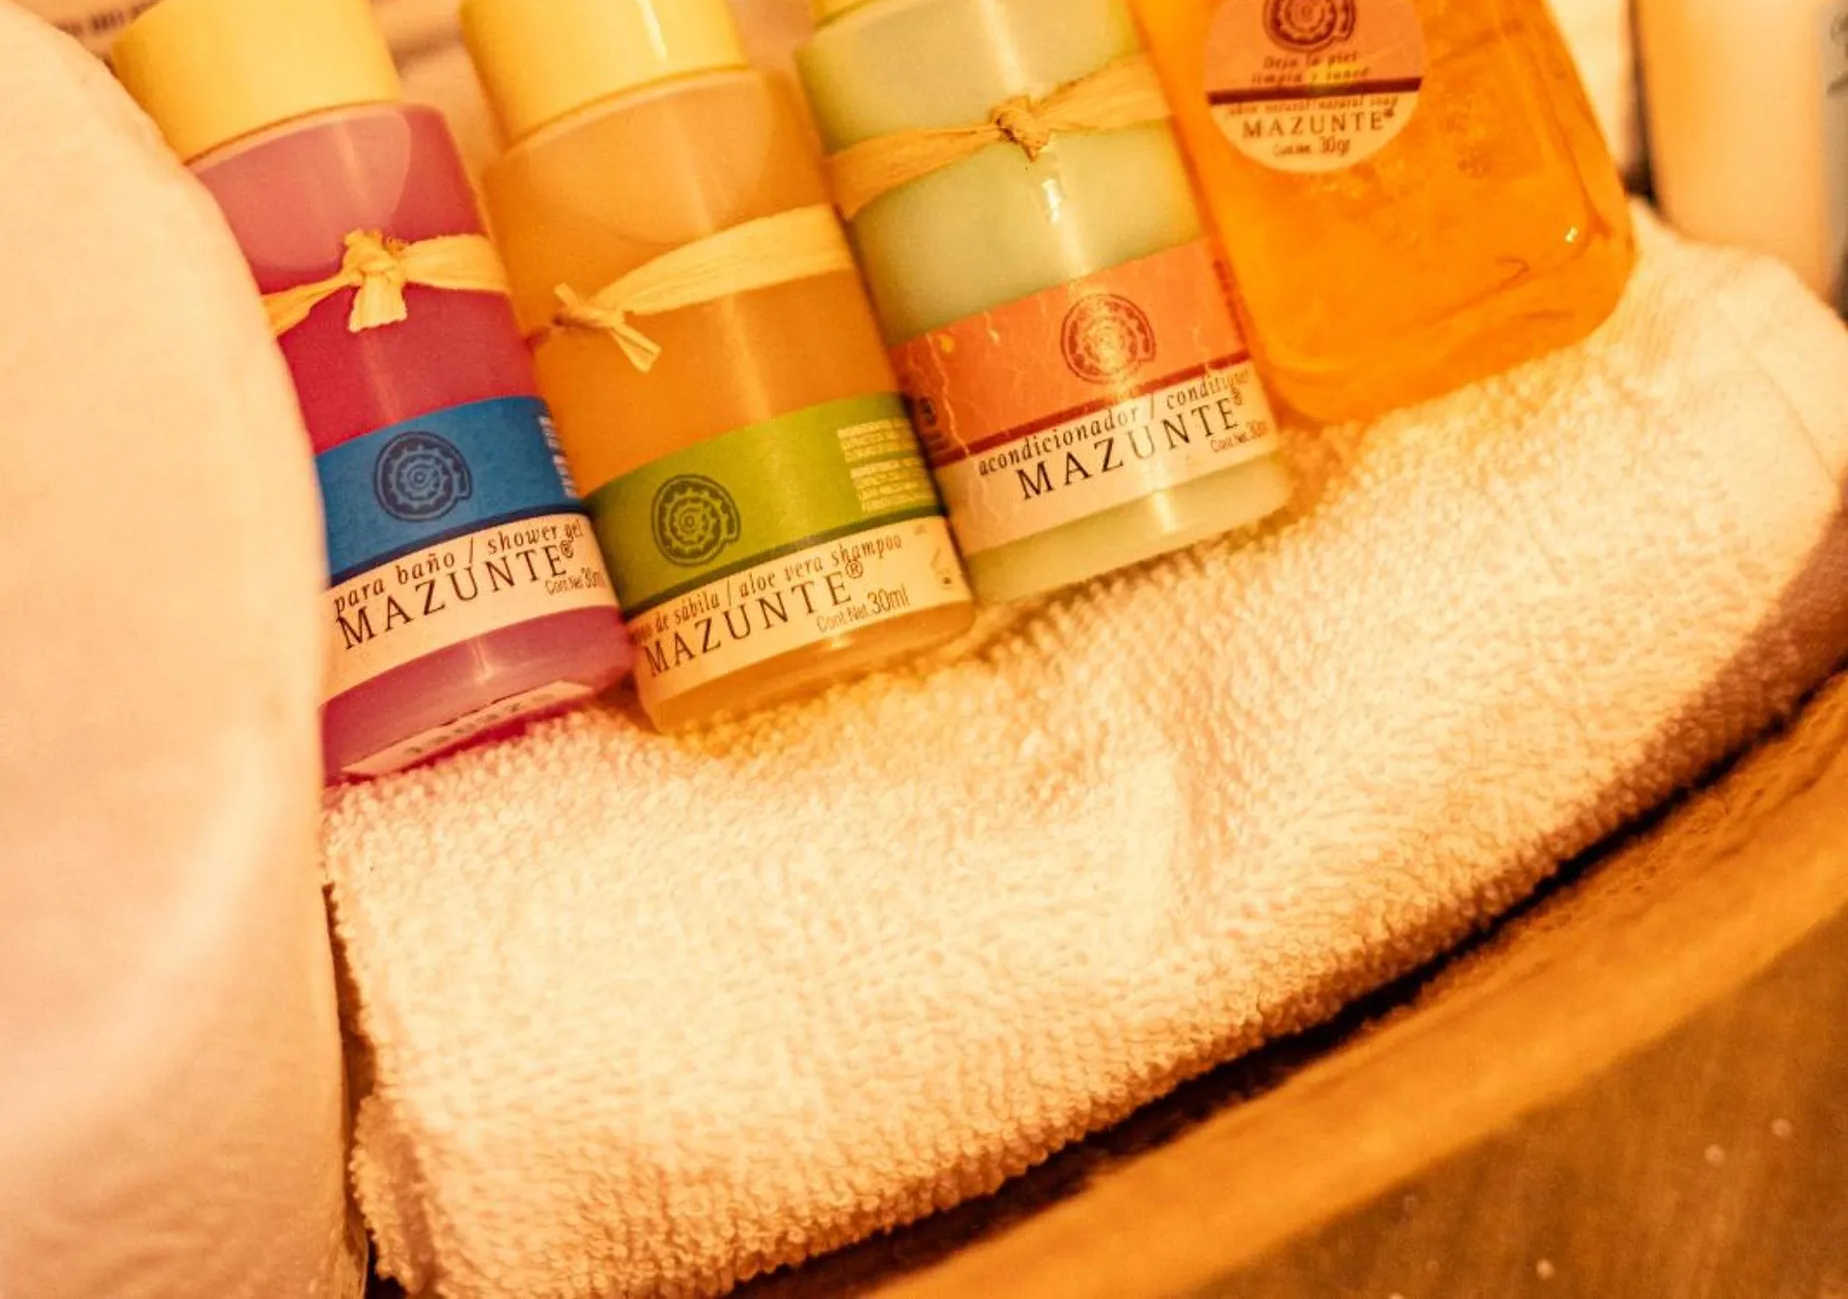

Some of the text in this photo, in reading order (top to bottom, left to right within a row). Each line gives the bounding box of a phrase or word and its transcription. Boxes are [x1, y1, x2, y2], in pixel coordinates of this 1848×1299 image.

[977, 402, 1140, 478] acondicionador
[334, 574, 386, 615] para
[397, 550, 456, 585] baño
[487, 525, 557, 556] shower
[564, 518, 584, 542] gel
[674, 590, 721, 626] sábila
[739, 570, 776, 598] aloe
[784, 557, 824, 583] vera
[831, 532, 903, 567] shampoo
[866, 580, 911, 615] 30ml
